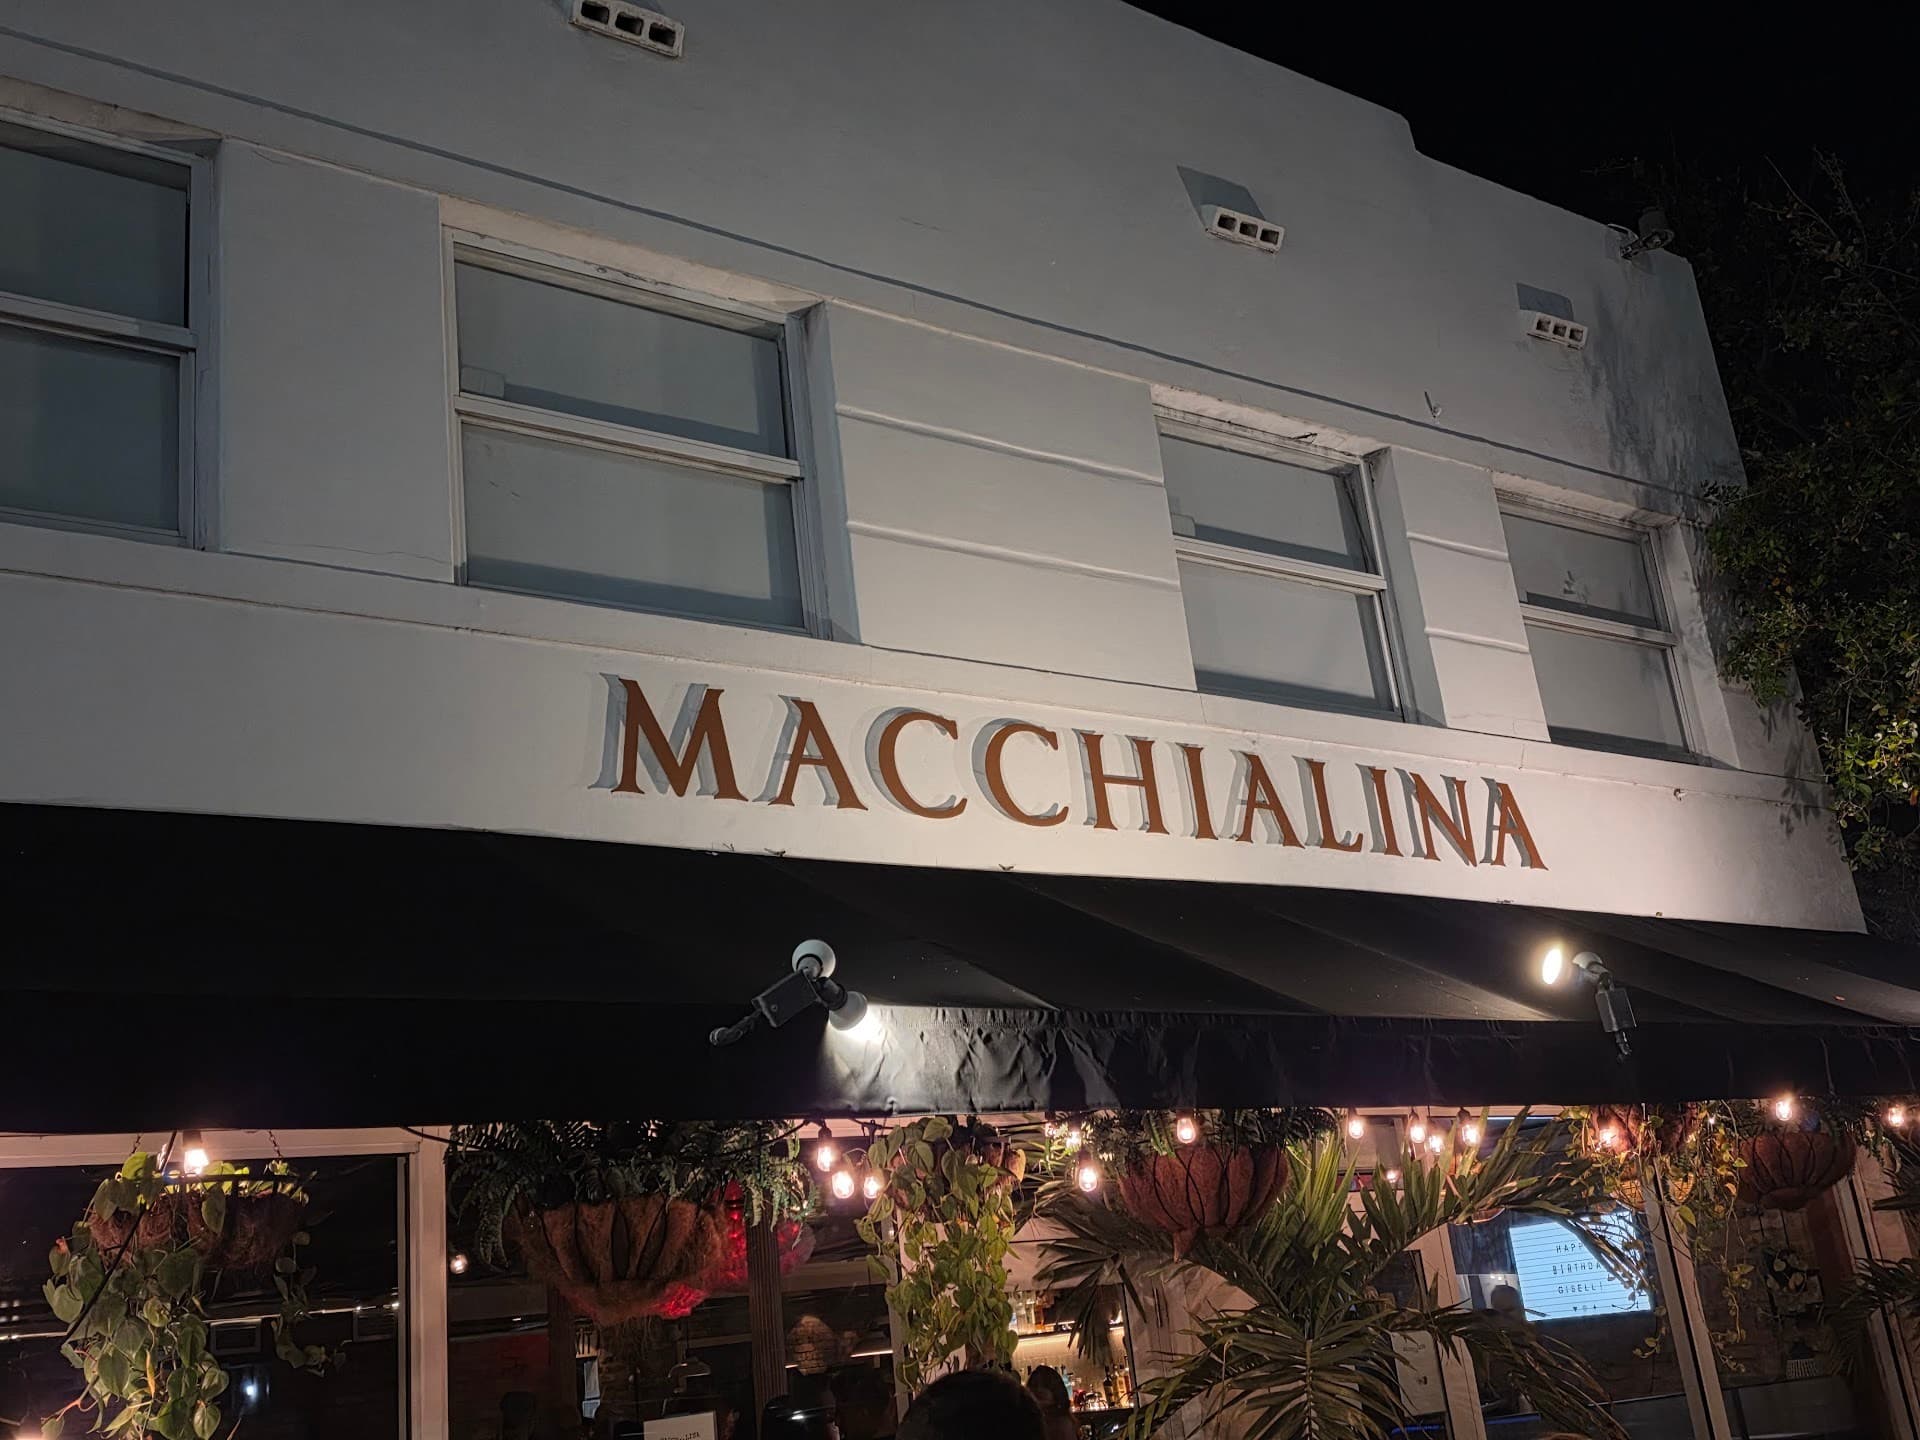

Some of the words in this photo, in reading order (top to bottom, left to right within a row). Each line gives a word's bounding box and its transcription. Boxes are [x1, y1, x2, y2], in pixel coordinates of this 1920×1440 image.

[608, 676, 1549, 870] MACCHIALINA
[1556, 1242, 1584, 1254] HAPP
[1552, 1261, 1602, 1275] BIRTHDA
